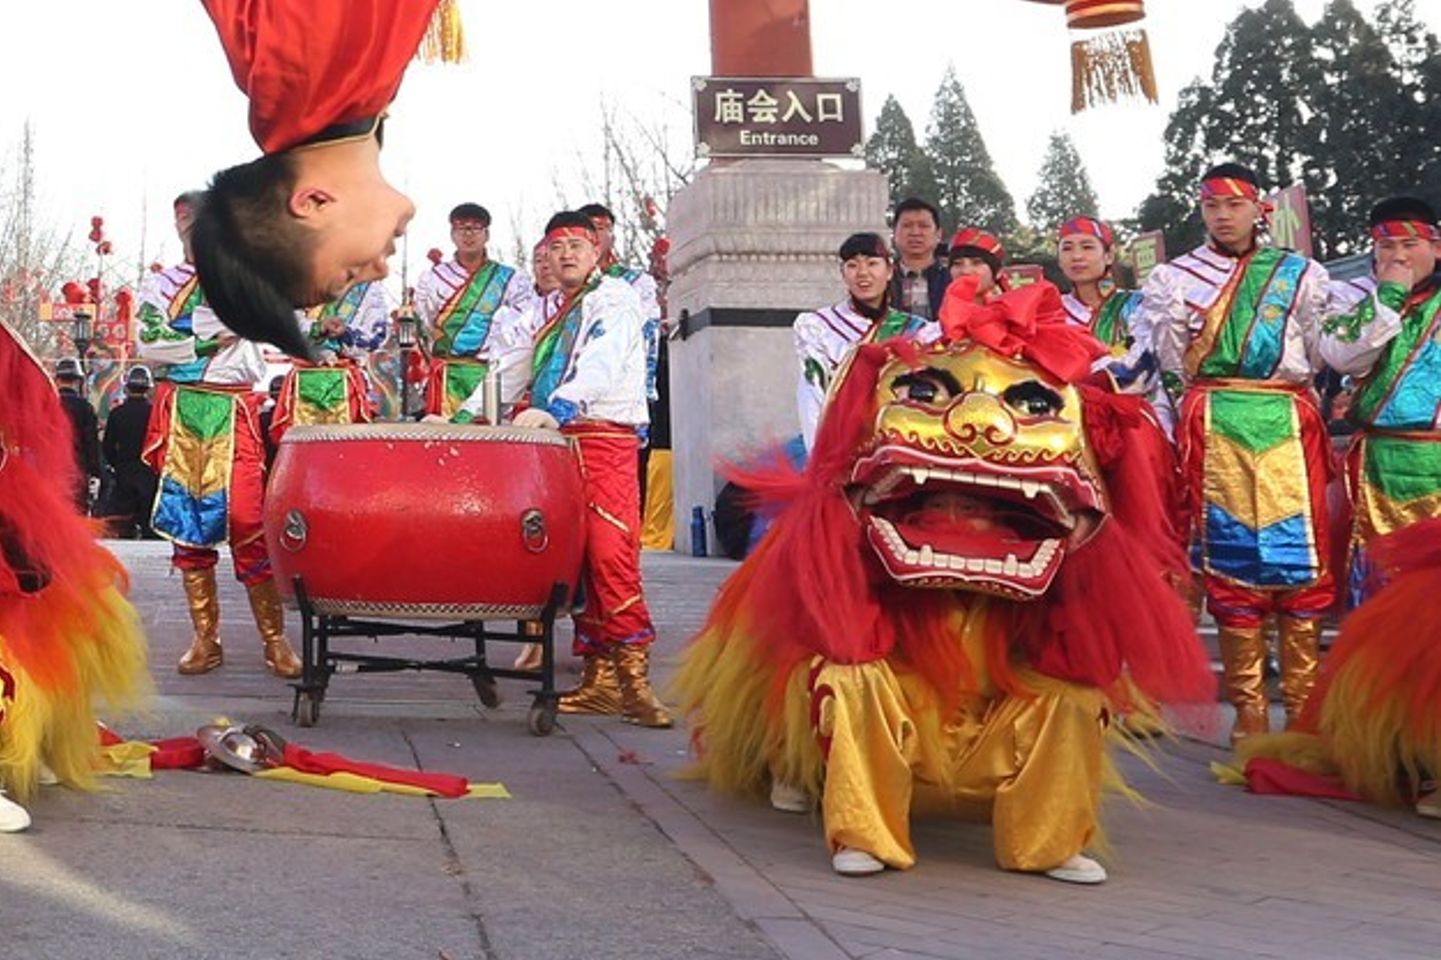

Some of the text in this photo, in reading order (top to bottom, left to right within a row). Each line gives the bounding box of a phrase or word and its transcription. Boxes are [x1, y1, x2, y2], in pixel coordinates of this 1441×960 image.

[714, 89, 844, 124] 庙会入口
[740, 130, 820, 145] Entrance
